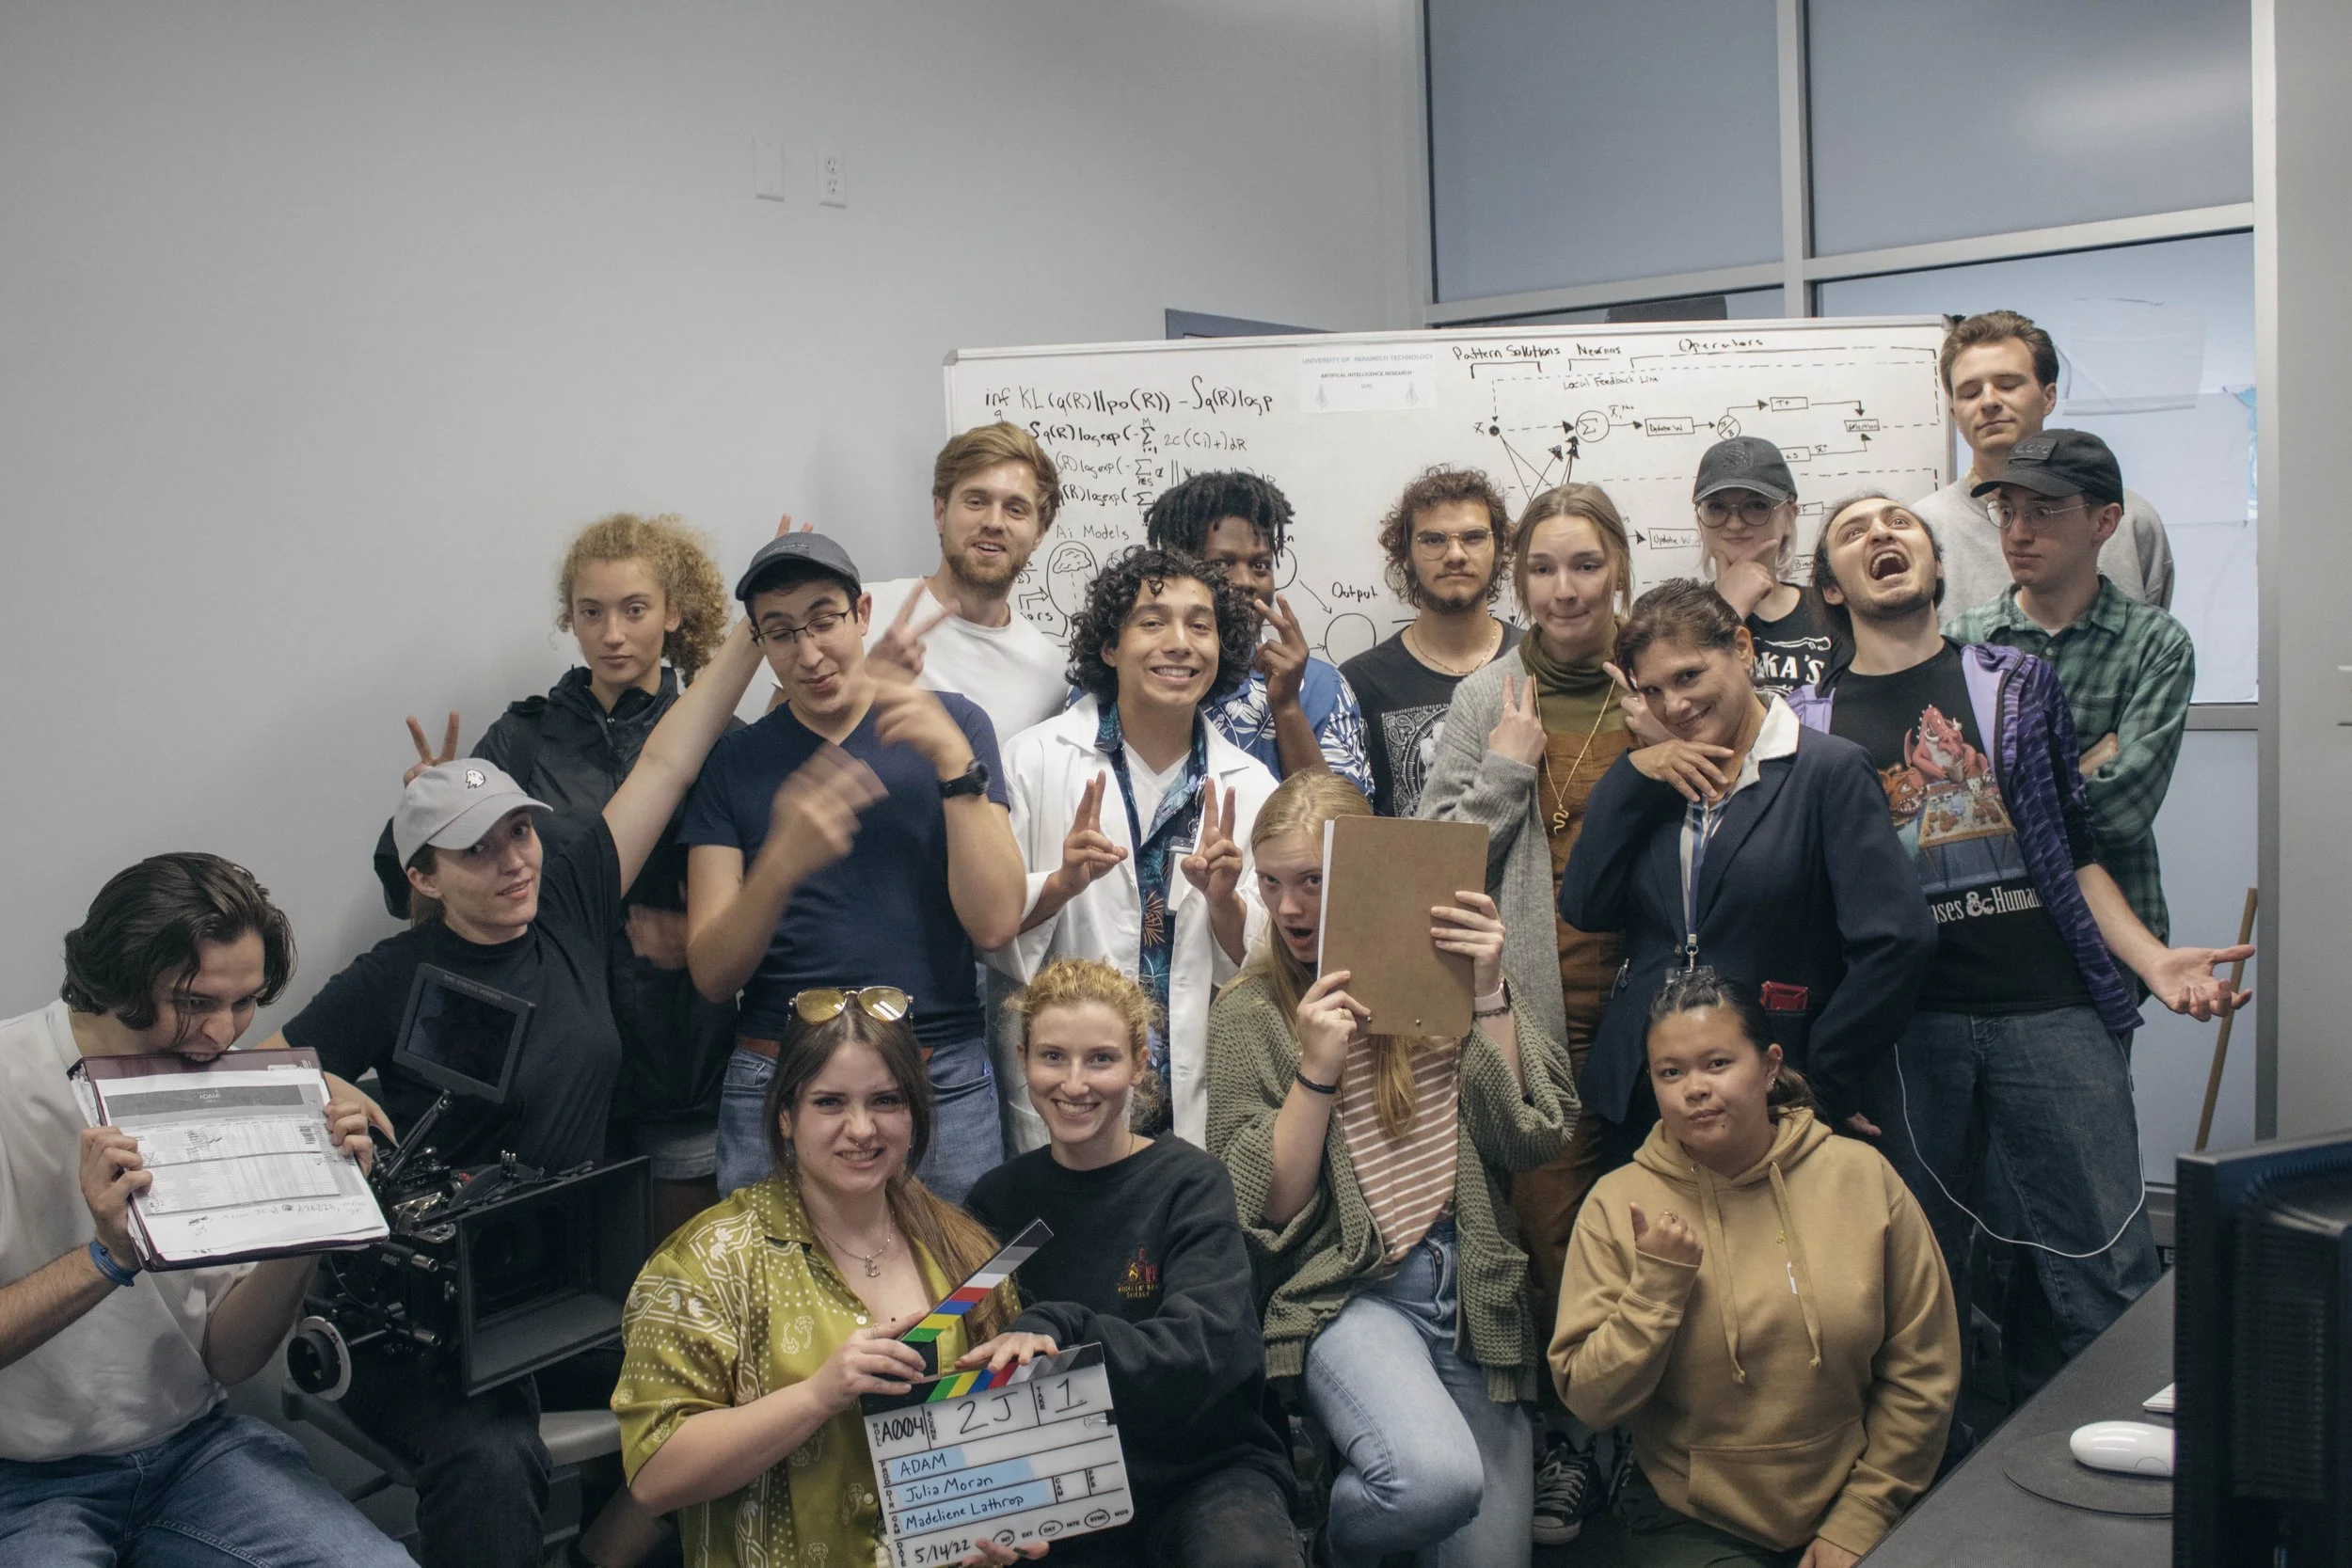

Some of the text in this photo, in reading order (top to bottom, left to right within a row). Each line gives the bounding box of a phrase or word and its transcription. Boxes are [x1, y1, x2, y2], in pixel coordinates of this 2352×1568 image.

[1302, 356, 1340, 365] UNIVERSITY
[1391, 353, 1434, 361] TECHNOLOGY
[1453, 346, 1502, 360] Pattern
[1594, 376, 1634, 388] Feedback
[1082, 523, 1131, 541] Models
[1652, 533, 1680, 546] Update
[1331, 580, 1379, 603] Output
[1036, 1386, 1046, 1411] TAKE
[872, 1421, 882, 1448] ROLL
[880, 1460, 891, 1486] PROD
[899, 1451, 947, 1478] ADAM
[904, 1477, 993, 1504] Julia Moran
[905, 1495, 1025, 1531] Madeliene Lathrop
[914, 1539, 972, 1564] 5/14/22
